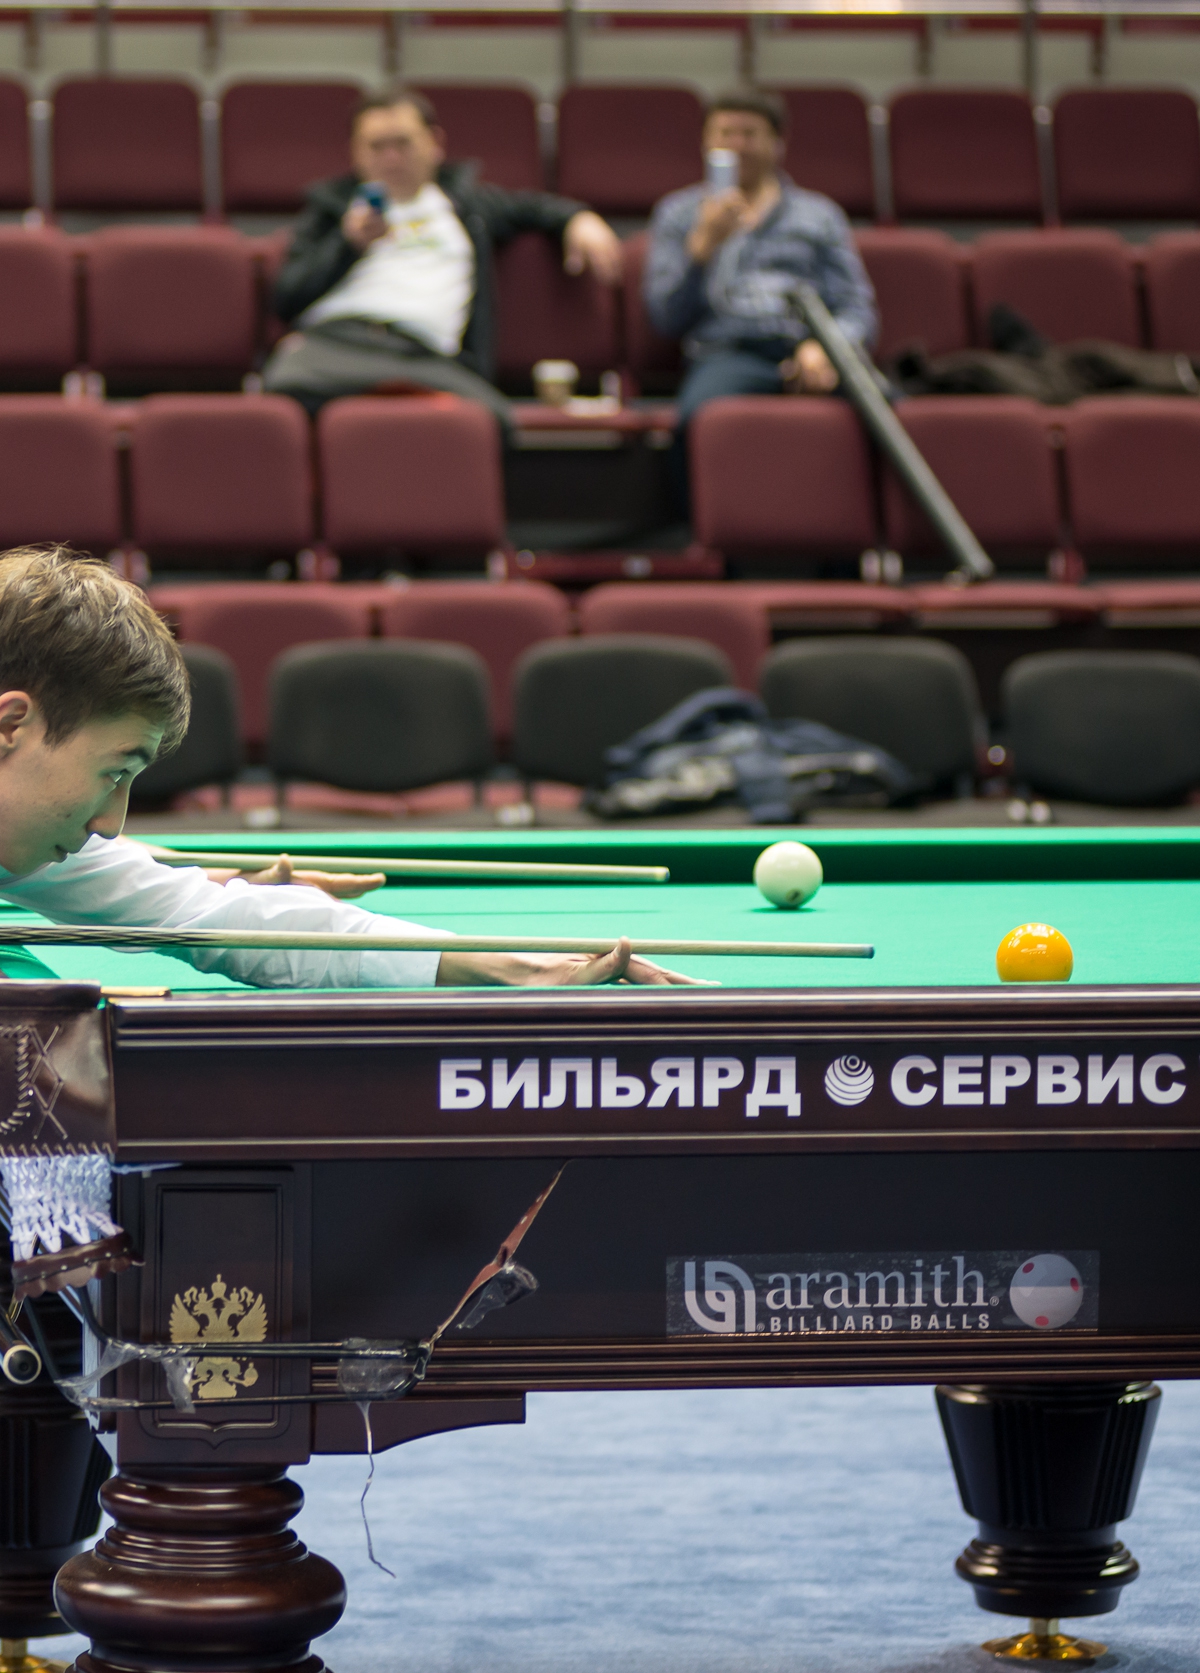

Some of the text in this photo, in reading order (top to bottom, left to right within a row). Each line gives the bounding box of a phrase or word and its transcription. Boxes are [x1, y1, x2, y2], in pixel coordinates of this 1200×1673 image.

[439, 1054, 1187, 1117] БИЛЬЯРД СЕРВИС
[765, 1256, 989, 1310] aramith
[770, 1313, 990, 1333] BILLIARD BALLS
